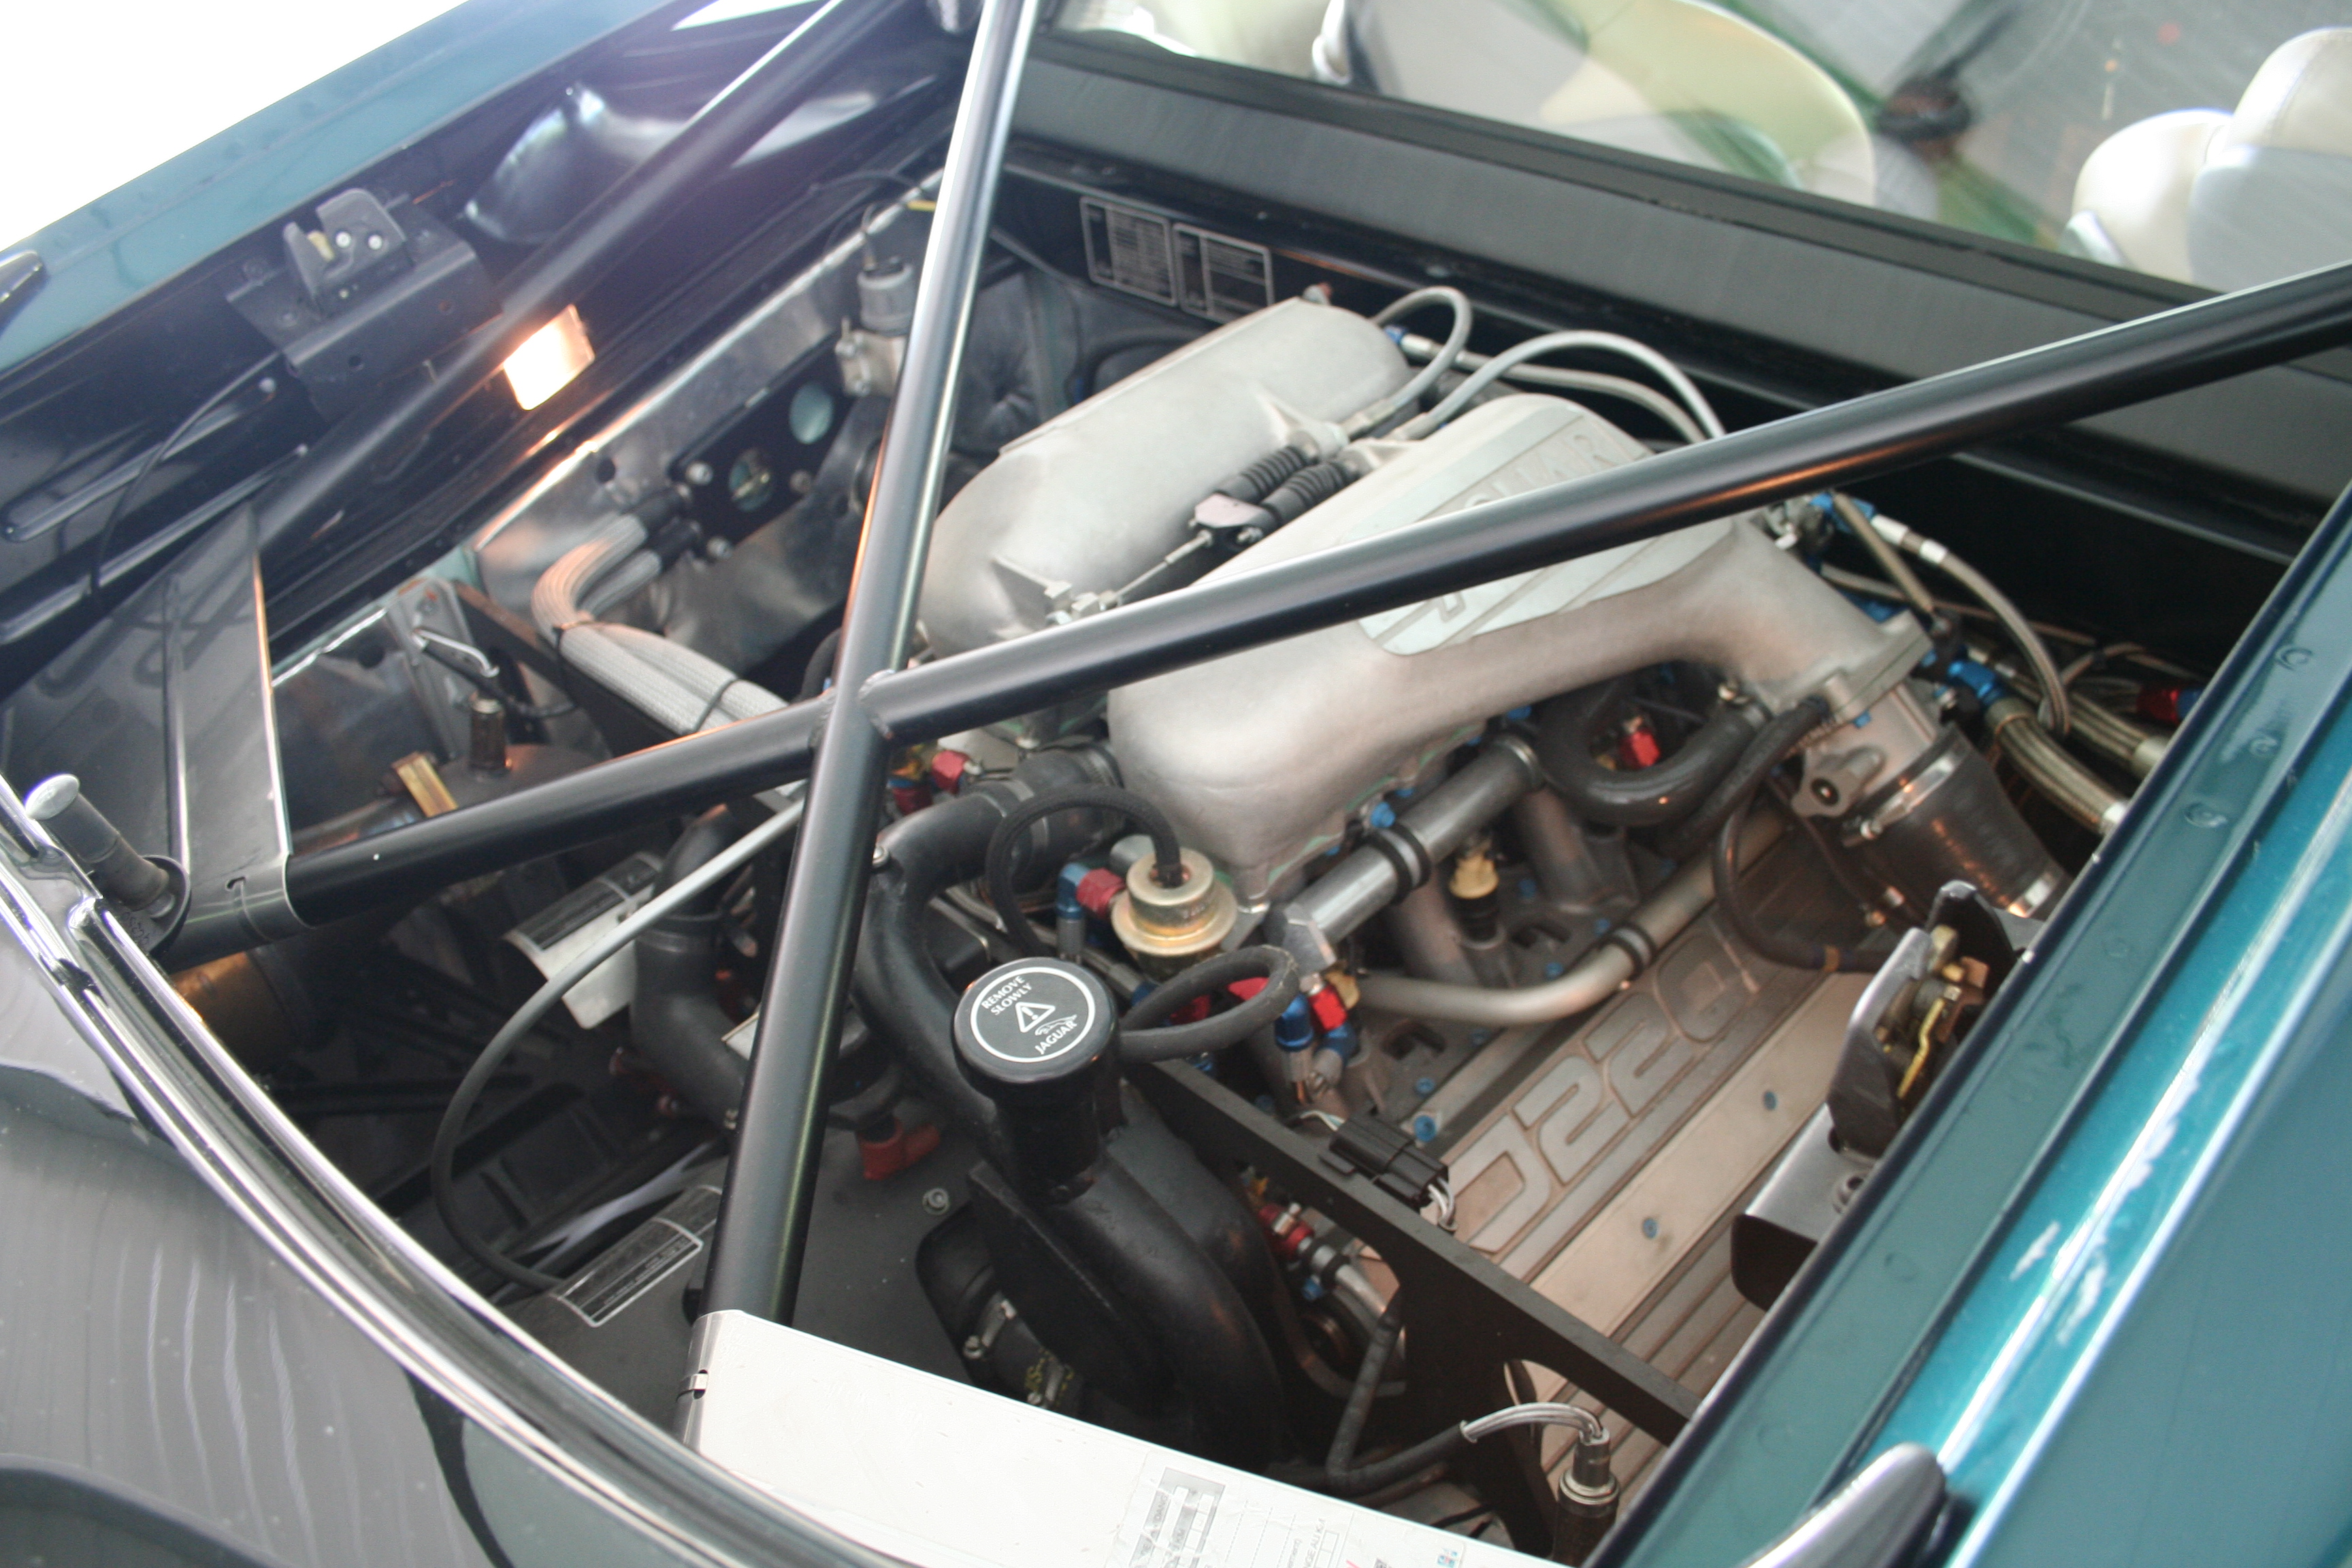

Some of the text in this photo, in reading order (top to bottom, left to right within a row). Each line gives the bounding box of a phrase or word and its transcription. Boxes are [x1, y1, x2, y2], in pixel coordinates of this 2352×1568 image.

[981, 975, 1025, 1009] REMOVE
[990, 983, 1032, 1016] SLOWLY
[1034, 1020, 1078, 1055] JAGUAR
[1421, 930, 1757, 1256] J220
